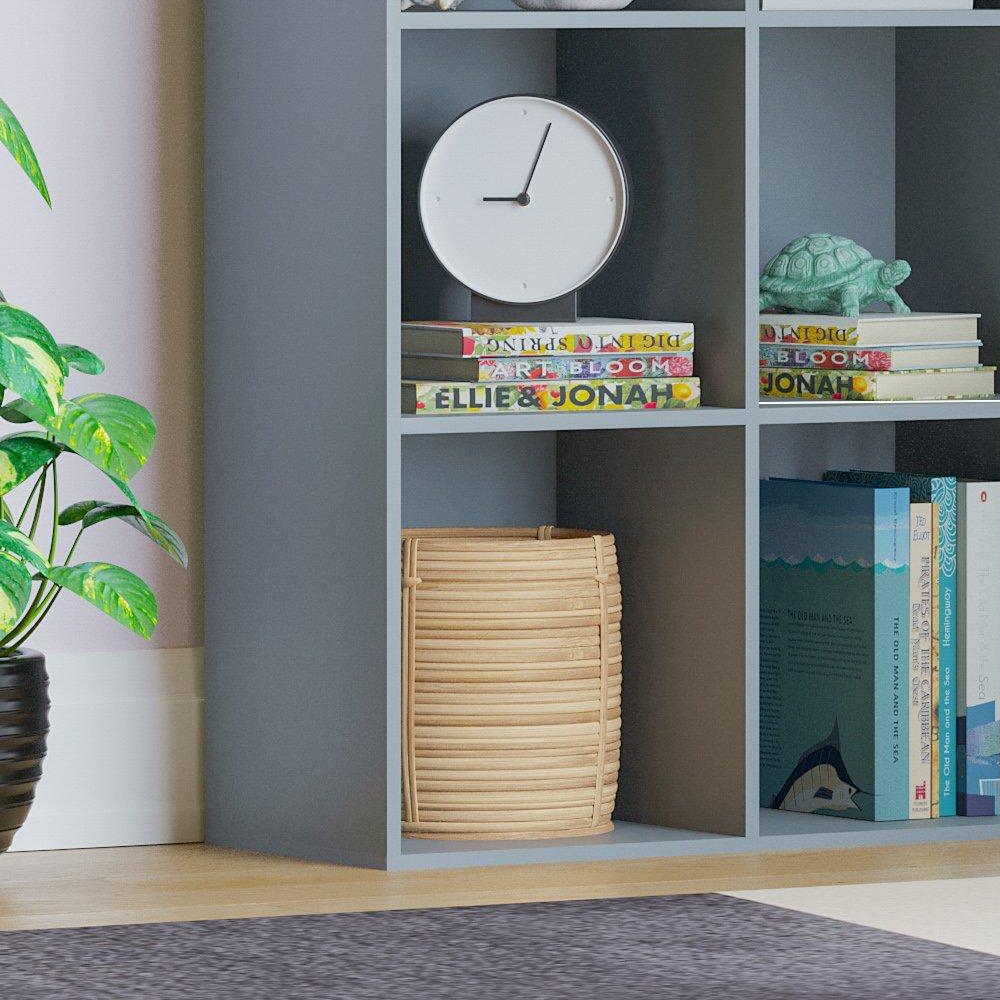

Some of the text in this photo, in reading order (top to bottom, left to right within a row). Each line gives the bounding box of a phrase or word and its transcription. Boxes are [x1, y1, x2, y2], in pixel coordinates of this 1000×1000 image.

[487, 336, 568, 352] SPRING
[643, 334, 681, 349] DIG
[817, 328, 846, 341] DIG
[492, 358, 671, 379] ART BLOOM
[777, 350, 870, 365] BLOOM
[763, 372, 853, 395] JONAH
[435, 383, 673, 410] ELLIE & JONAH
[942, 587, 951, 647] Hemingway
[919, 620, 930, 641] OF
[921, 648, 930, 675] THE
[978, 675, 989, 700] Sea
[918, 679, 930, 764] CARIBBEAN
